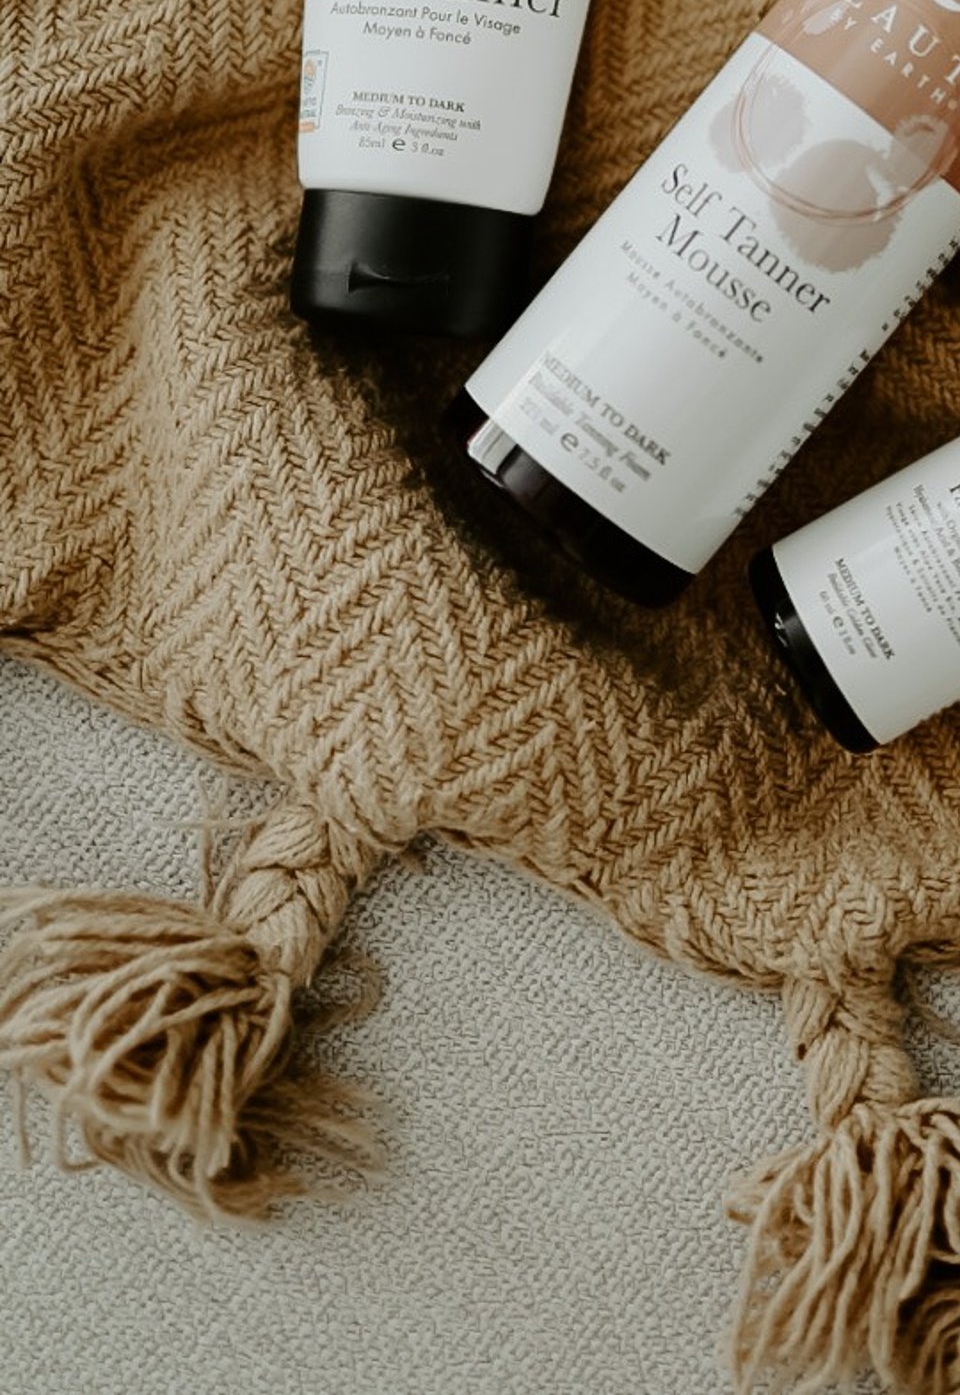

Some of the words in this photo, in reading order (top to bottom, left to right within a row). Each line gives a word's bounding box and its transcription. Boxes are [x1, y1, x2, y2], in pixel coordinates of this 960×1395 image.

[330, 1, 418, 18] Autobronzant
[421, 6, 452, 22] Pour
[456, 10, 468, 25] le
[474, 13, 521, 36] Visage
[362, 21, 411, 40] Moyen
[415, 26, 425, 39] à
[429, 28, 472, 45] Foncé
[352, 91, 404, 105] MEDIUM
[407, 95, 425, 106] TO
[429, 97, 465, 113] DARK
[656, 213, 771, 323] Mousse
[661, 163, 722, 217] Self
[719, 206, 831, 315] Tanner
[541, 353, 602, 408] MEDIUM
[599, 402, 625, 428] TO
[623, 423, 671, 466] DARK
[834, 557, 865, 606] MEDIUM
[860, 606, 876, 626] TO
[870, 626, 896, 660] DARK
